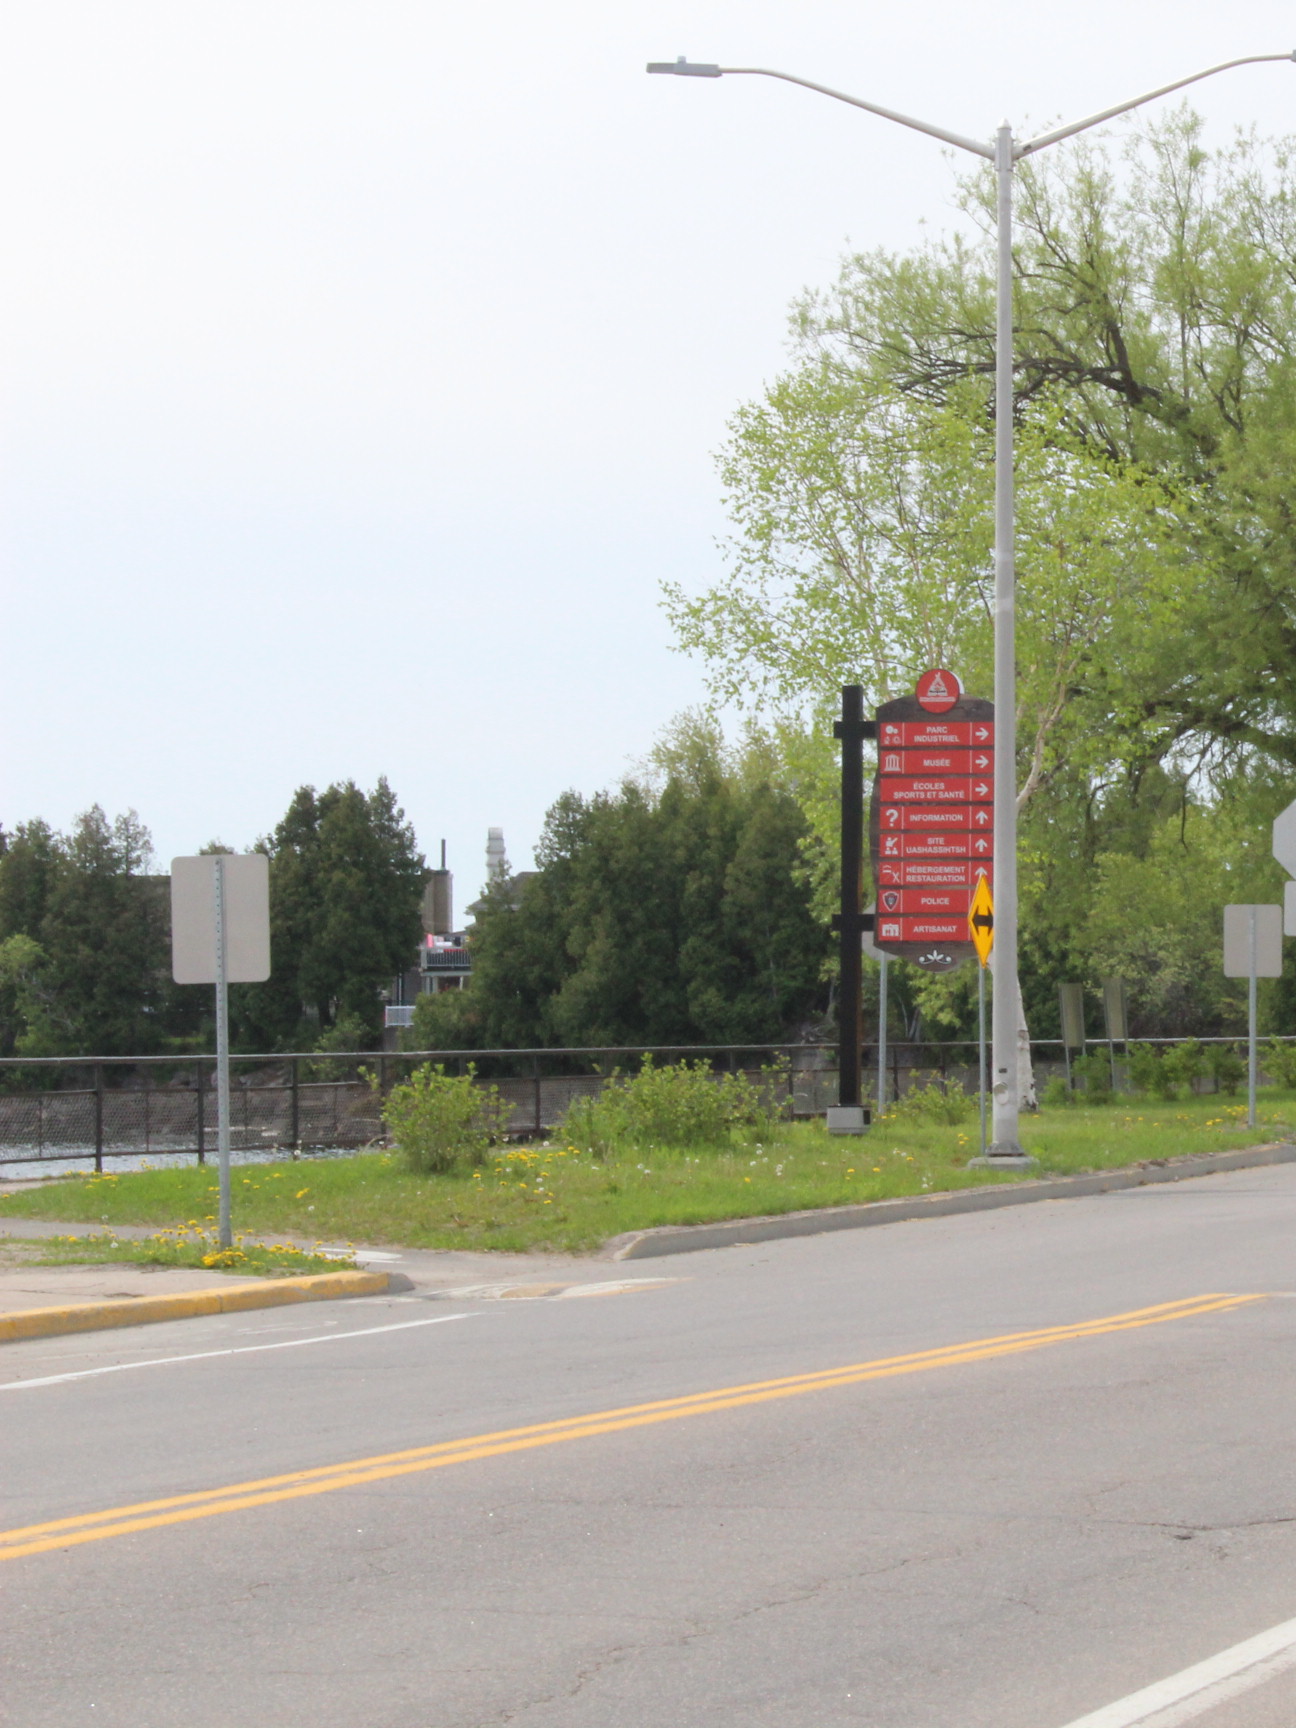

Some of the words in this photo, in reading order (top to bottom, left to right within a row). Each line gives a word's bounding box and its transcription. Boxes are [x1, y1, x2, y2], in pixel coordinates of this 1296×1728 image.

[926, 726, 948, 734] PARC
[914, 735, 960, 743] INDUSTRIEL
[923, 757, 951, 767] MUSÉE
[913, 780, 945, 790] ÉCOLES
[893, 791, 925, 799] SPORTS
[926, 791, 936, 799] ET
[938, 789, 965, 799] SANTÉ
[909, 814, 963, 822] INFORMATION
[927, 837, 945, 845] SITE
[906, 865, 965, 874] HÉBERGEMENT
[920, 897, 950, 905] POLICE
[913, 925, 957, 933] ARTISANAT
